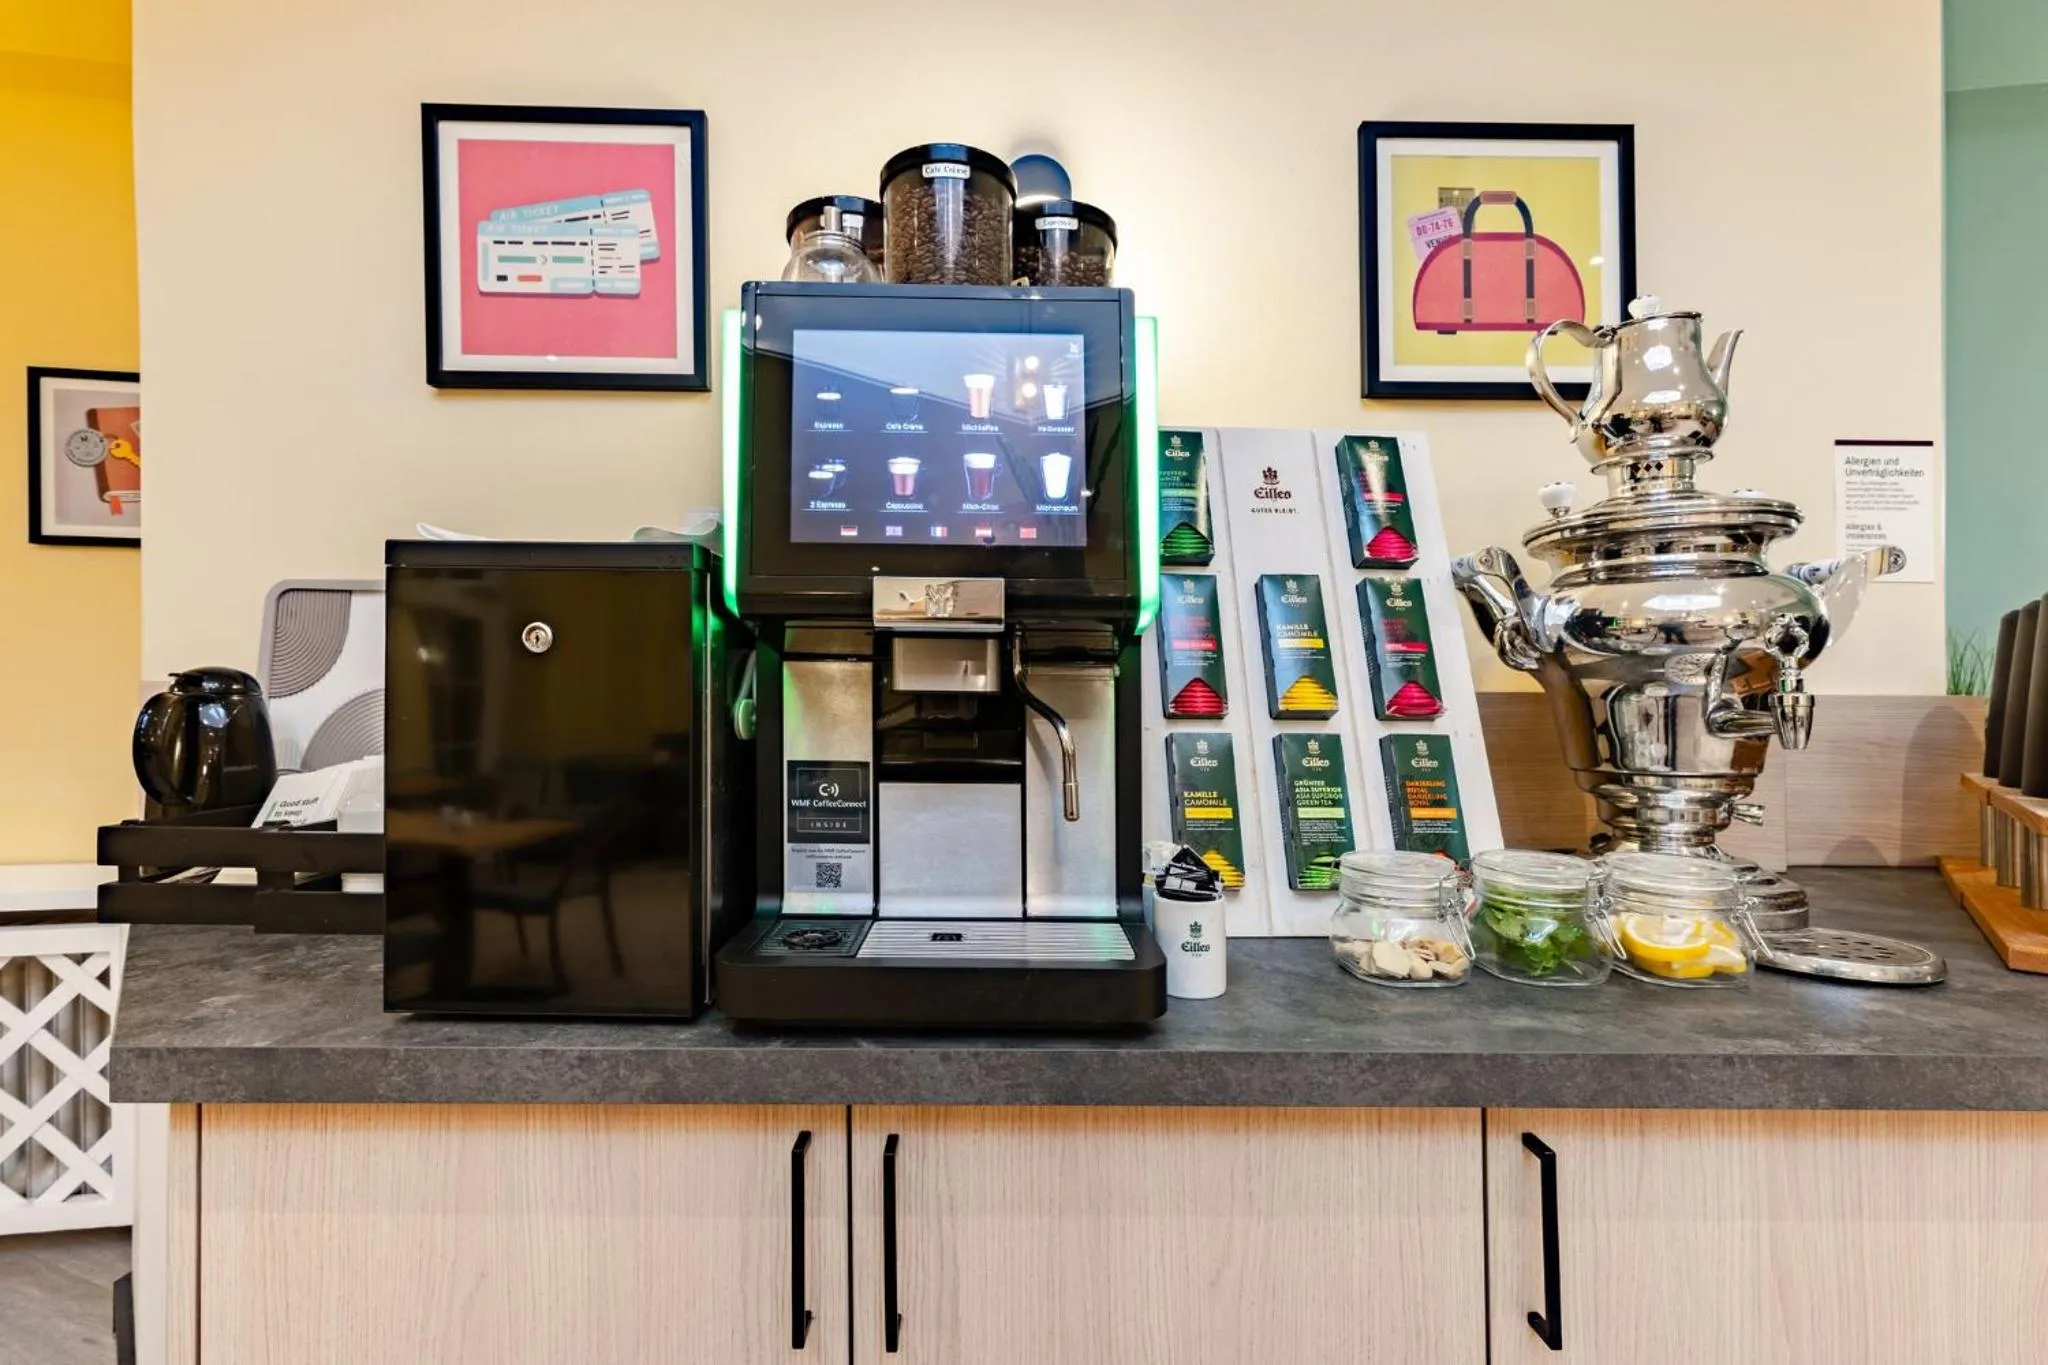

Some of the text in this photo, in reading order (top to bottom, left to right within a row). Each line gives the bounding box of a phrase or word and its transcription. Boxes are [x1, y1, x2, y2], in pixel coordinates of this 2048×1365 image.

[500, 204, 558, 219] AIR TICKET
[814, 420, 845, 431] Espresso
[1165, 449, 1190, 458] Eilles
[1845, 456, 1900, 467] Allergien und
[1845, 467, 1924, 478] Unverträglichkeiten
[1253, 486, 1292, 500] Eilles
[816, 500, 846, 511] Espresso
[885, 502, 924, 511] Cappuccino
[1178, 594, 1205, 604] Eilles
[1281, 594, 1308, 604] Eilles
[1385, 598, 1413, 607] Eilles
[1190, 757, 1219, 767] Eilles
[1302, 757, 1330, 767] Eilles
[1411, 758, 1439, 768] Eilles
[813, 800, 867, 808] CoffeeConnect
[1181, 941, 1211, 953] Eilles
